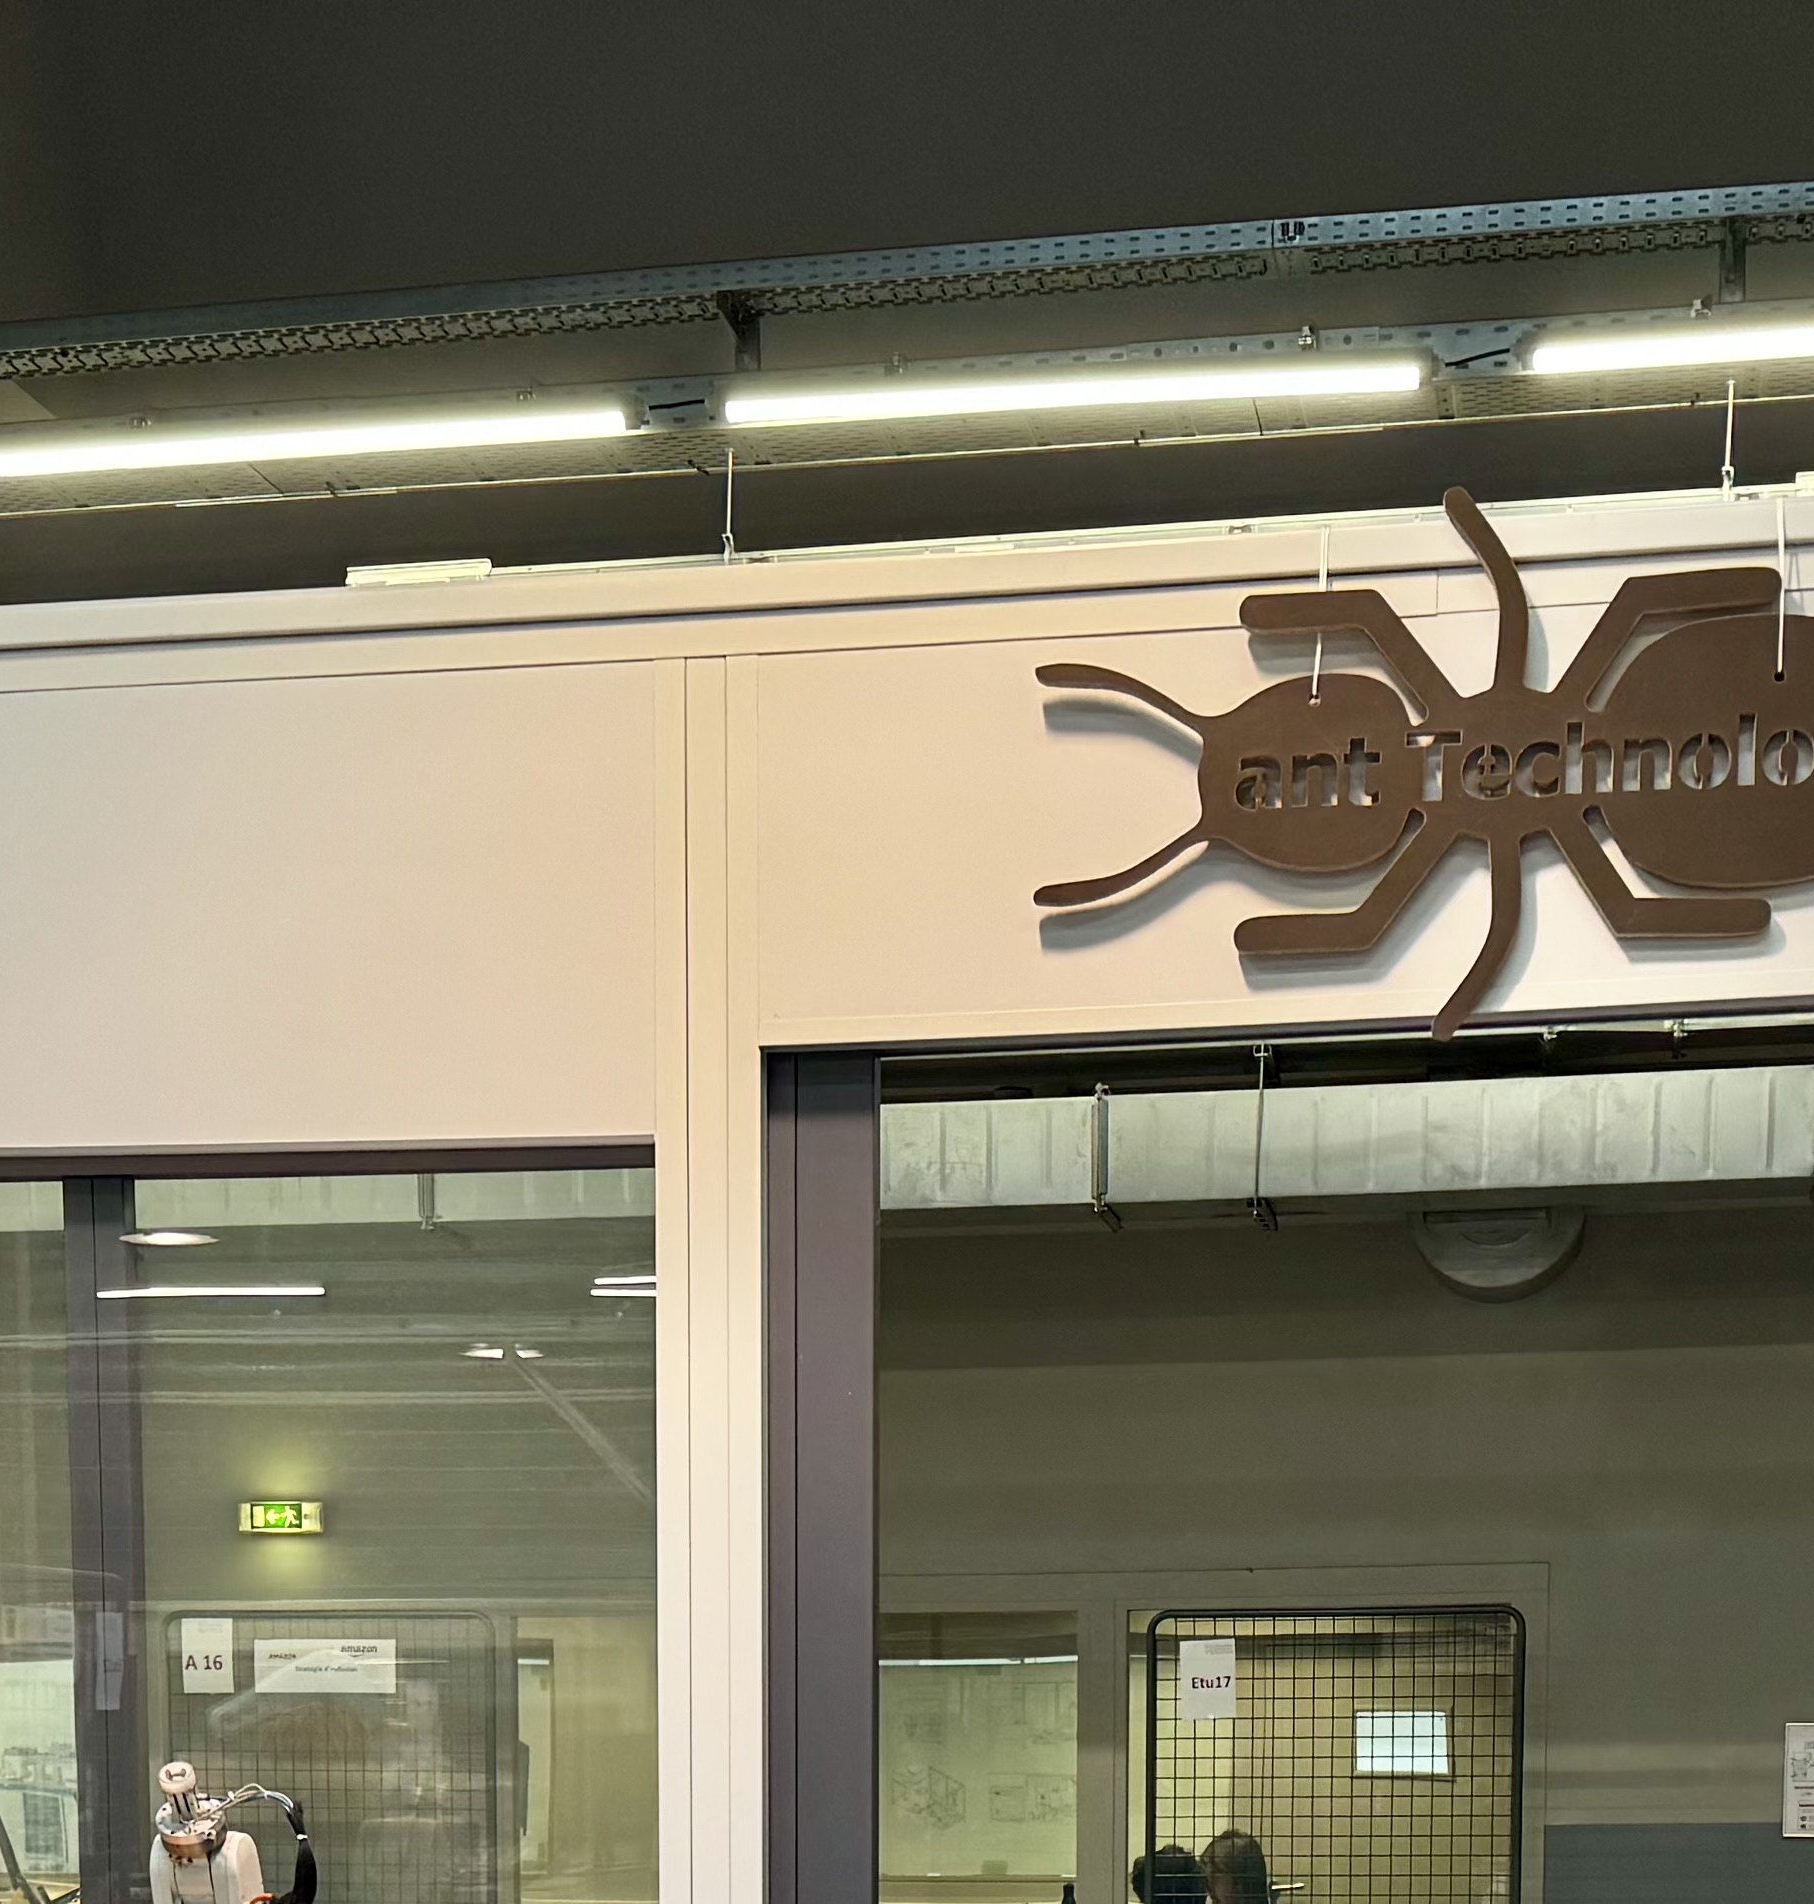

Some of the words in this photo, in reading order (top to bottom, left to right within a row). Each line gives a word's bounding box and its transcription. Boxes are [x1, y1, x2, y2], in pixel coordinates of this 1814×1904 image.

[1234, 736, 1382, 809] ant
[185, 1656, 197, 1670] A
[204, 1655, 223, 1670] 16
[1192, 1676, 1231, 1689] Etu17
